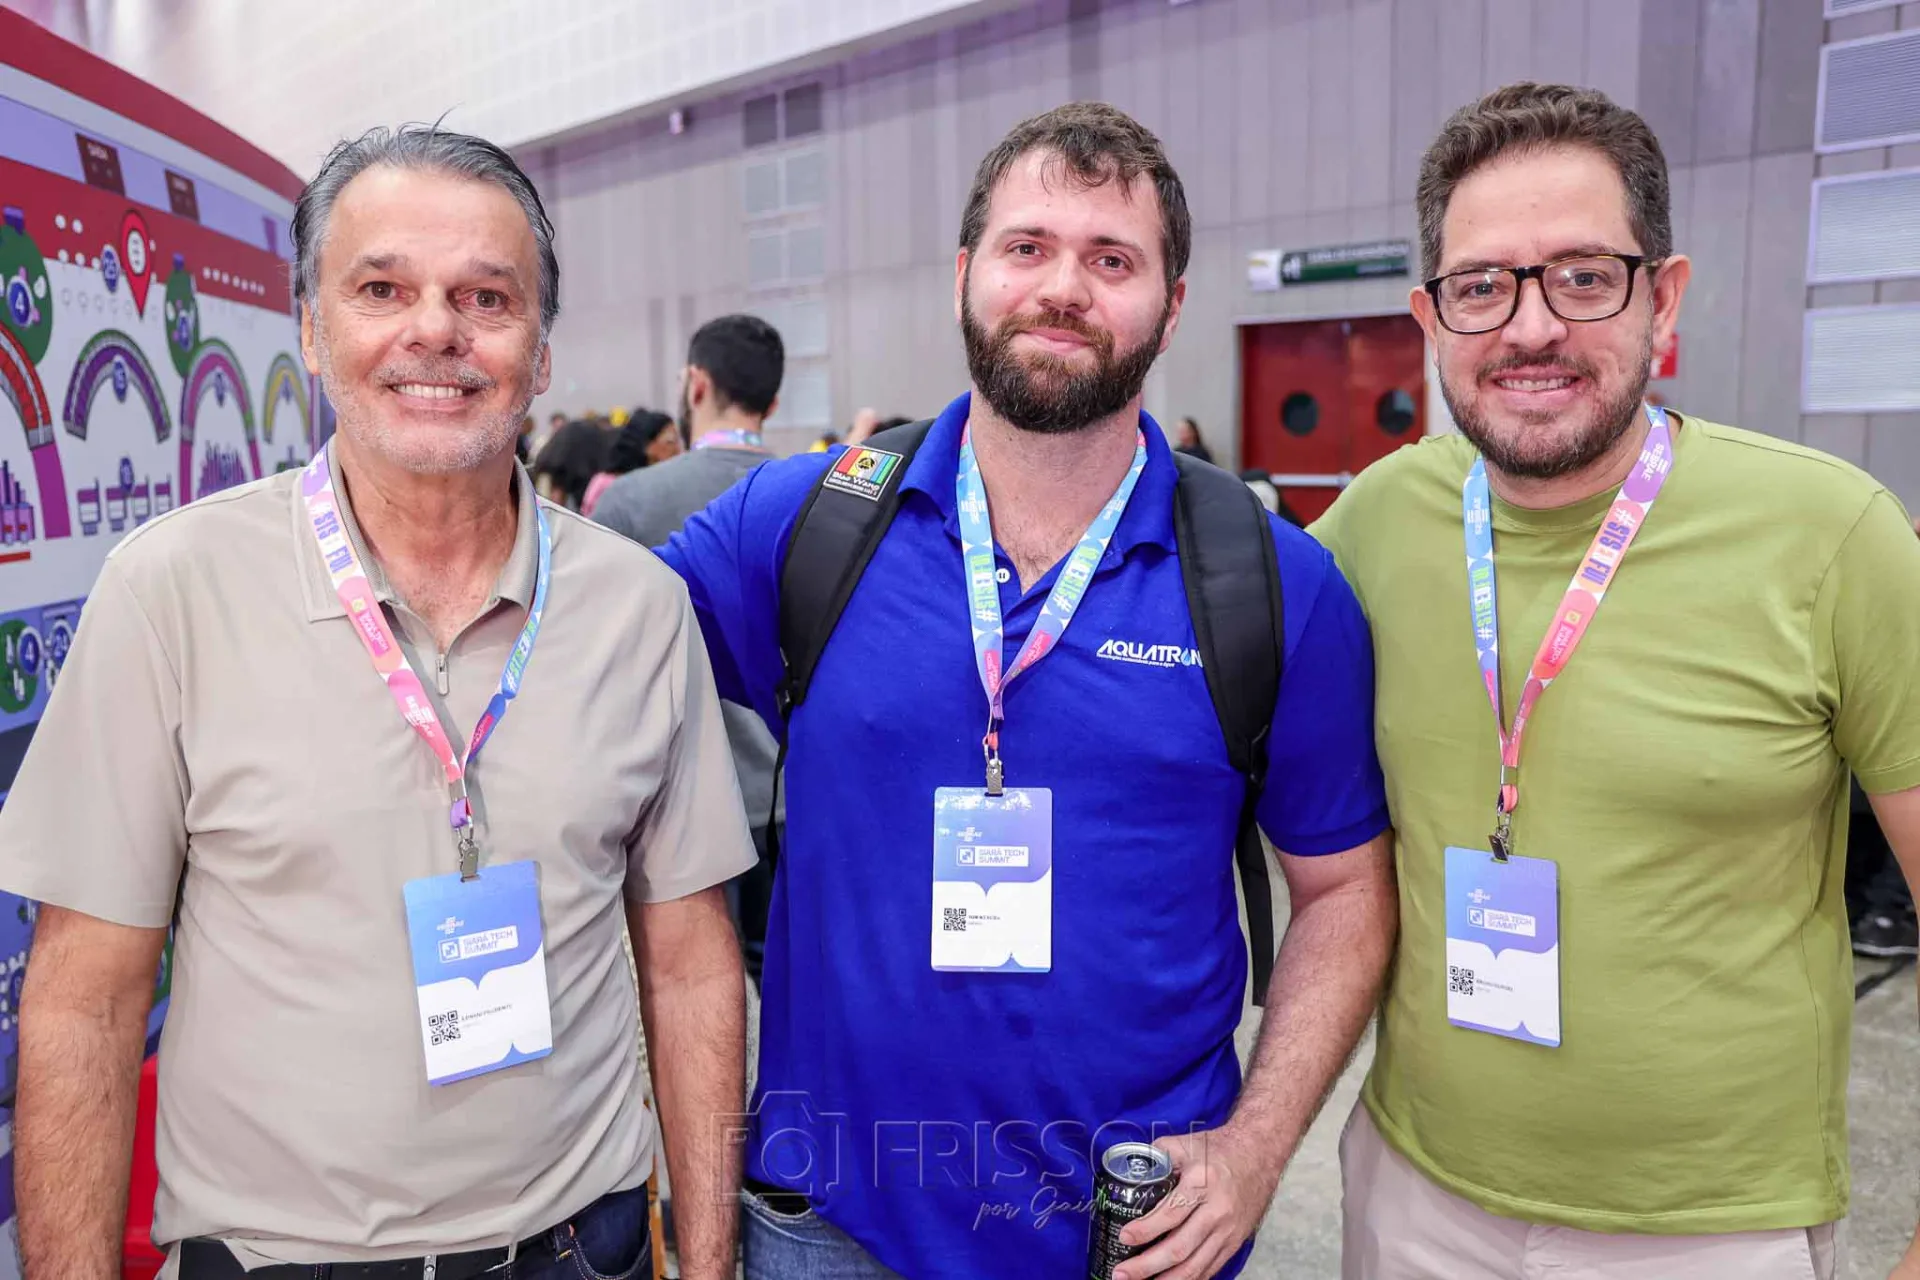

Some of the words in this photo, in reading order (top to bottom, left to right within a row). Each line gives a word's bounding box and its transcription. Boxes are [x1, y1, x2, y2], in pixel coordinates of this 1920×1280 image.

[15, 291, 26, 314] 4
[1642, 443, 1665, 481] SEBRAE
[1108, 1183, 1155, 1198] GUAANA
